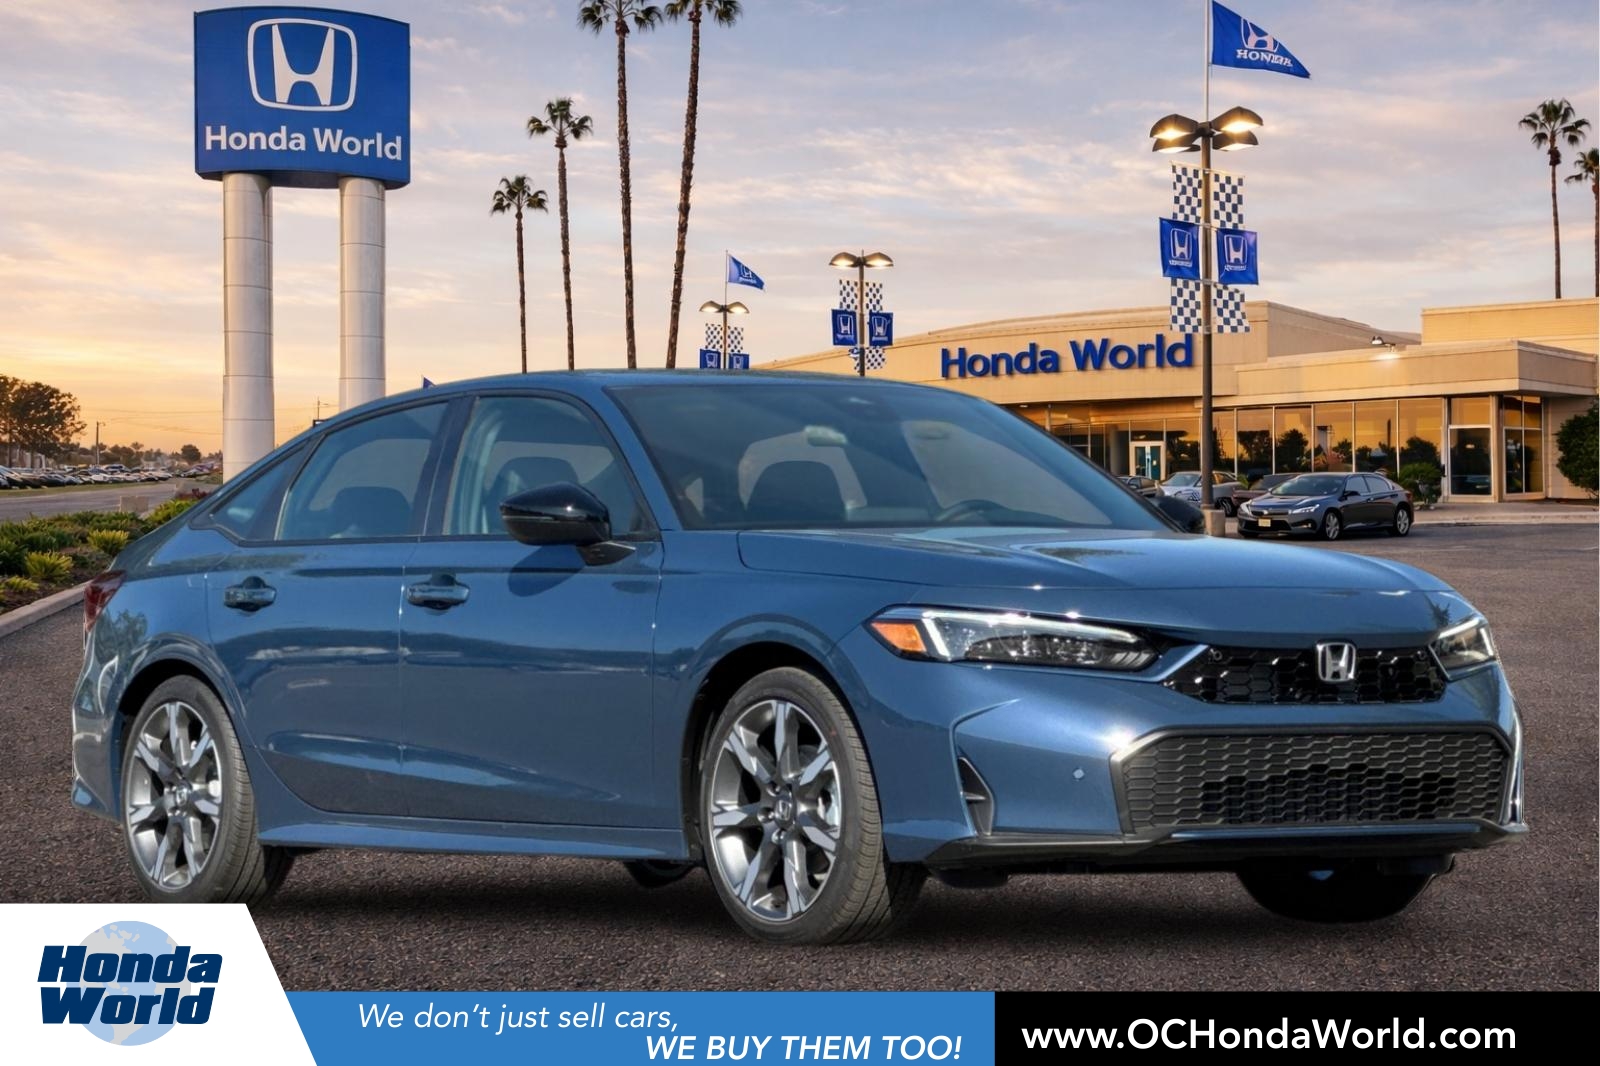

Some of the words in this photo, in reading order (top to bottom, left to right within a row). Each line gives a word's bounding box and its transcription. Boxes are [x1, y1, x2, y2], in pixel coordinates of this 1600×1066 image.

[205, 125, 306, 151] Honda
[313, 128, 402, 161] World
[941, 342, 1060, 378] Honda
[1069, 333, 1194, 372] World
